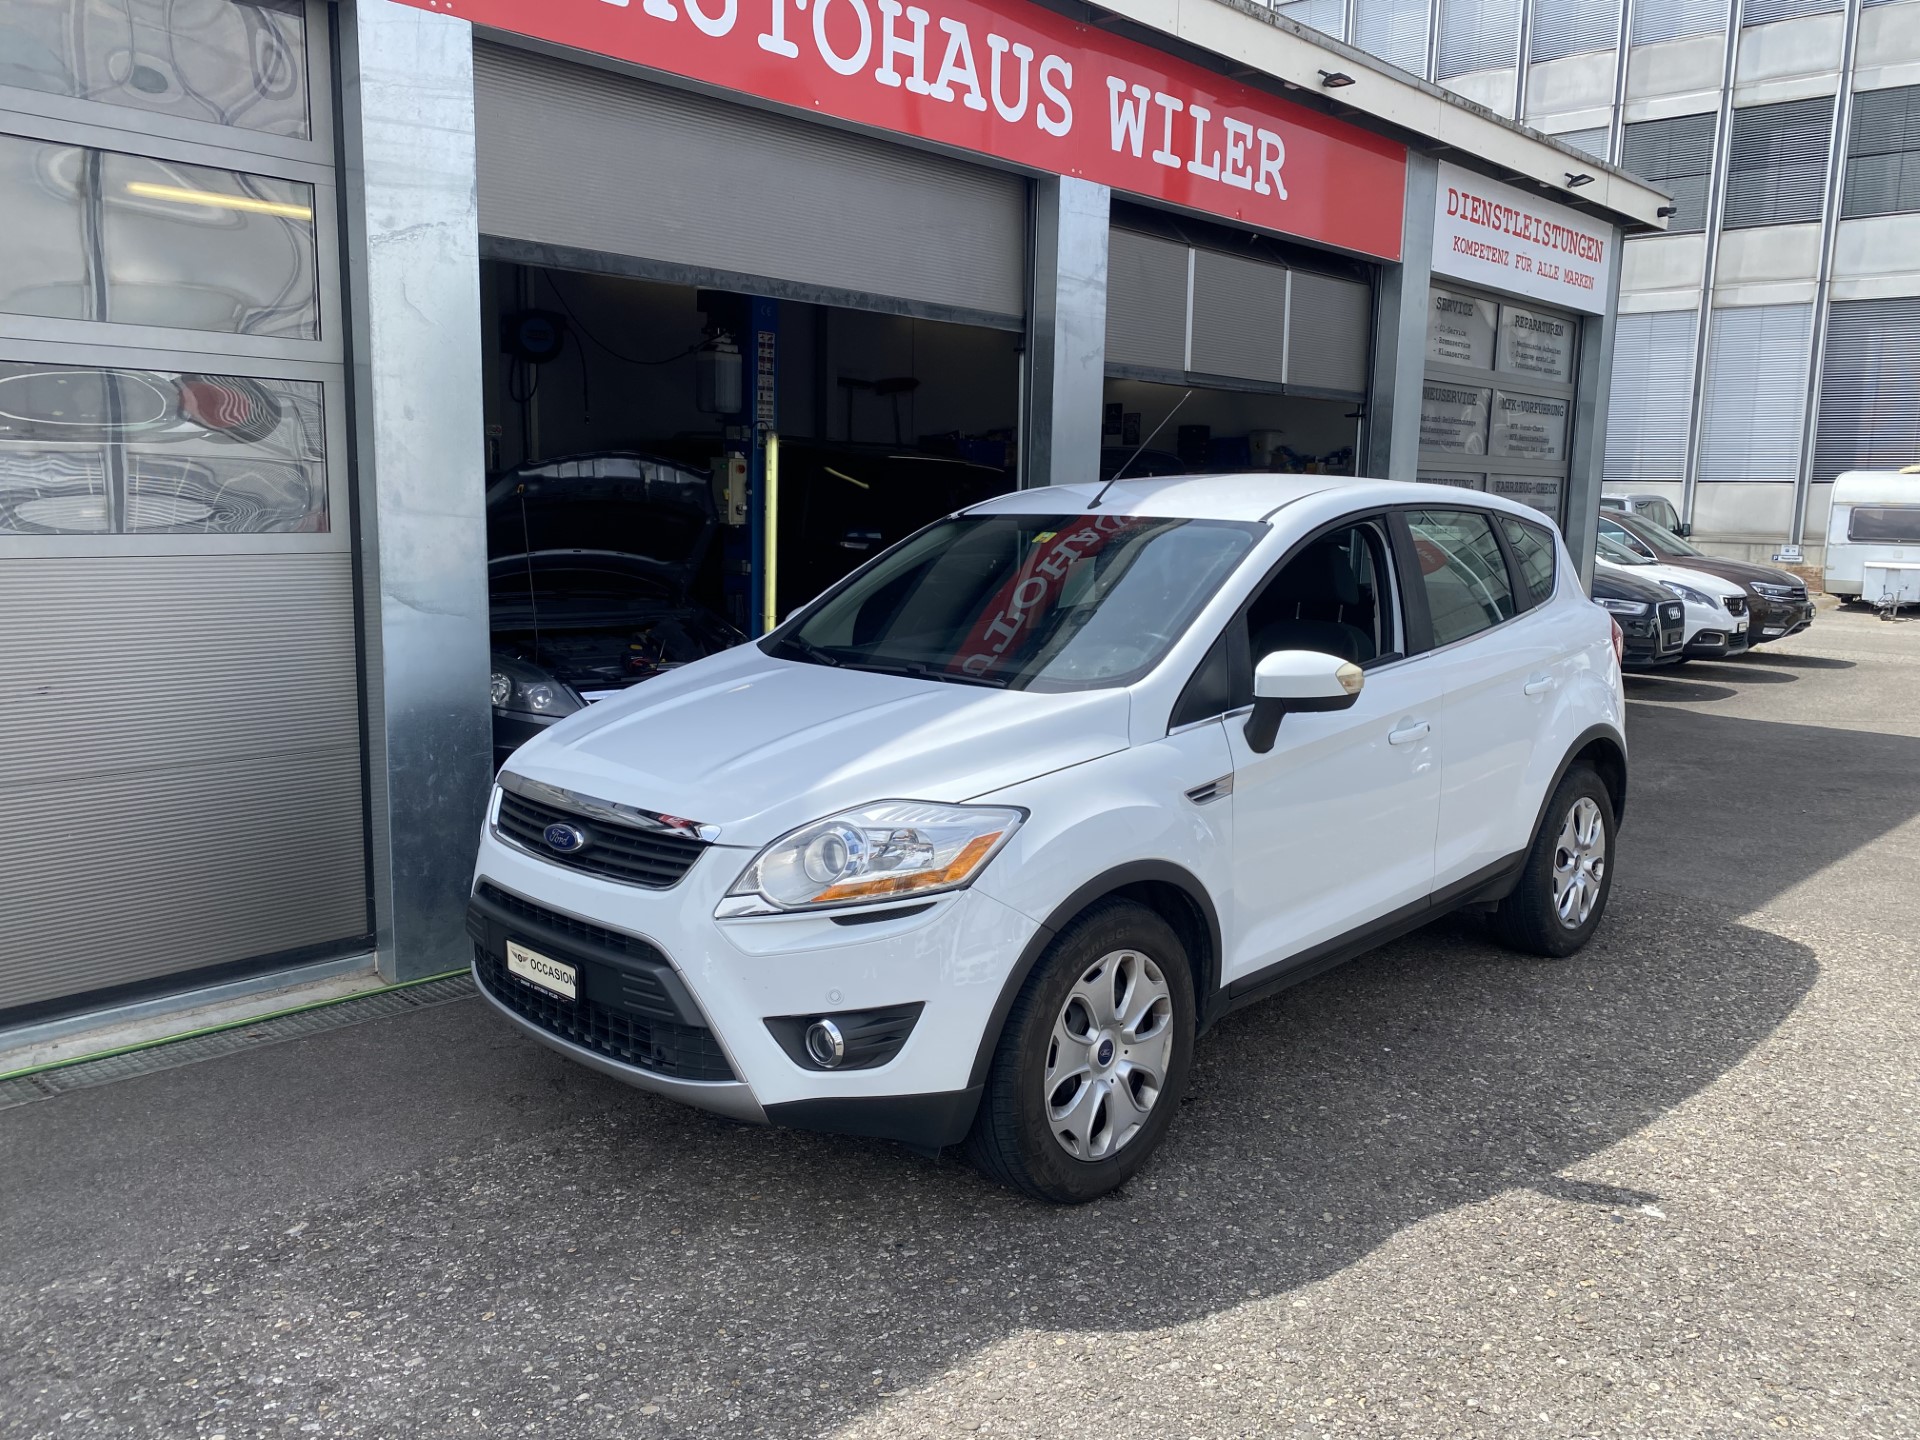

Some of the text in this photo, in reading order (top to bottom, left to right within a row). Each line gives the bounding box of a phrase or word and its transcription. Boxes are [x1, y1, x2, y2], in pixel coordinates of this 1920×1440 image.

[600, 0, 1289, 202] TOHAUS WILER
[1446, 187, 1605, 264] DIENSTLEISTUNGEN
[1452, 235, 1595, 291] KOMPETENZ FÜR ALLE MARKEN
[1436, 296, 1474, 317] SERVICE
[1514, 314, 1564, 337] REPARATUREN
[1495, 480, 1558, 495] FAHRZEUG-CHECK
[549, 827, 570, 846] Ford
[530, 958, 577, 987] OCCASION
